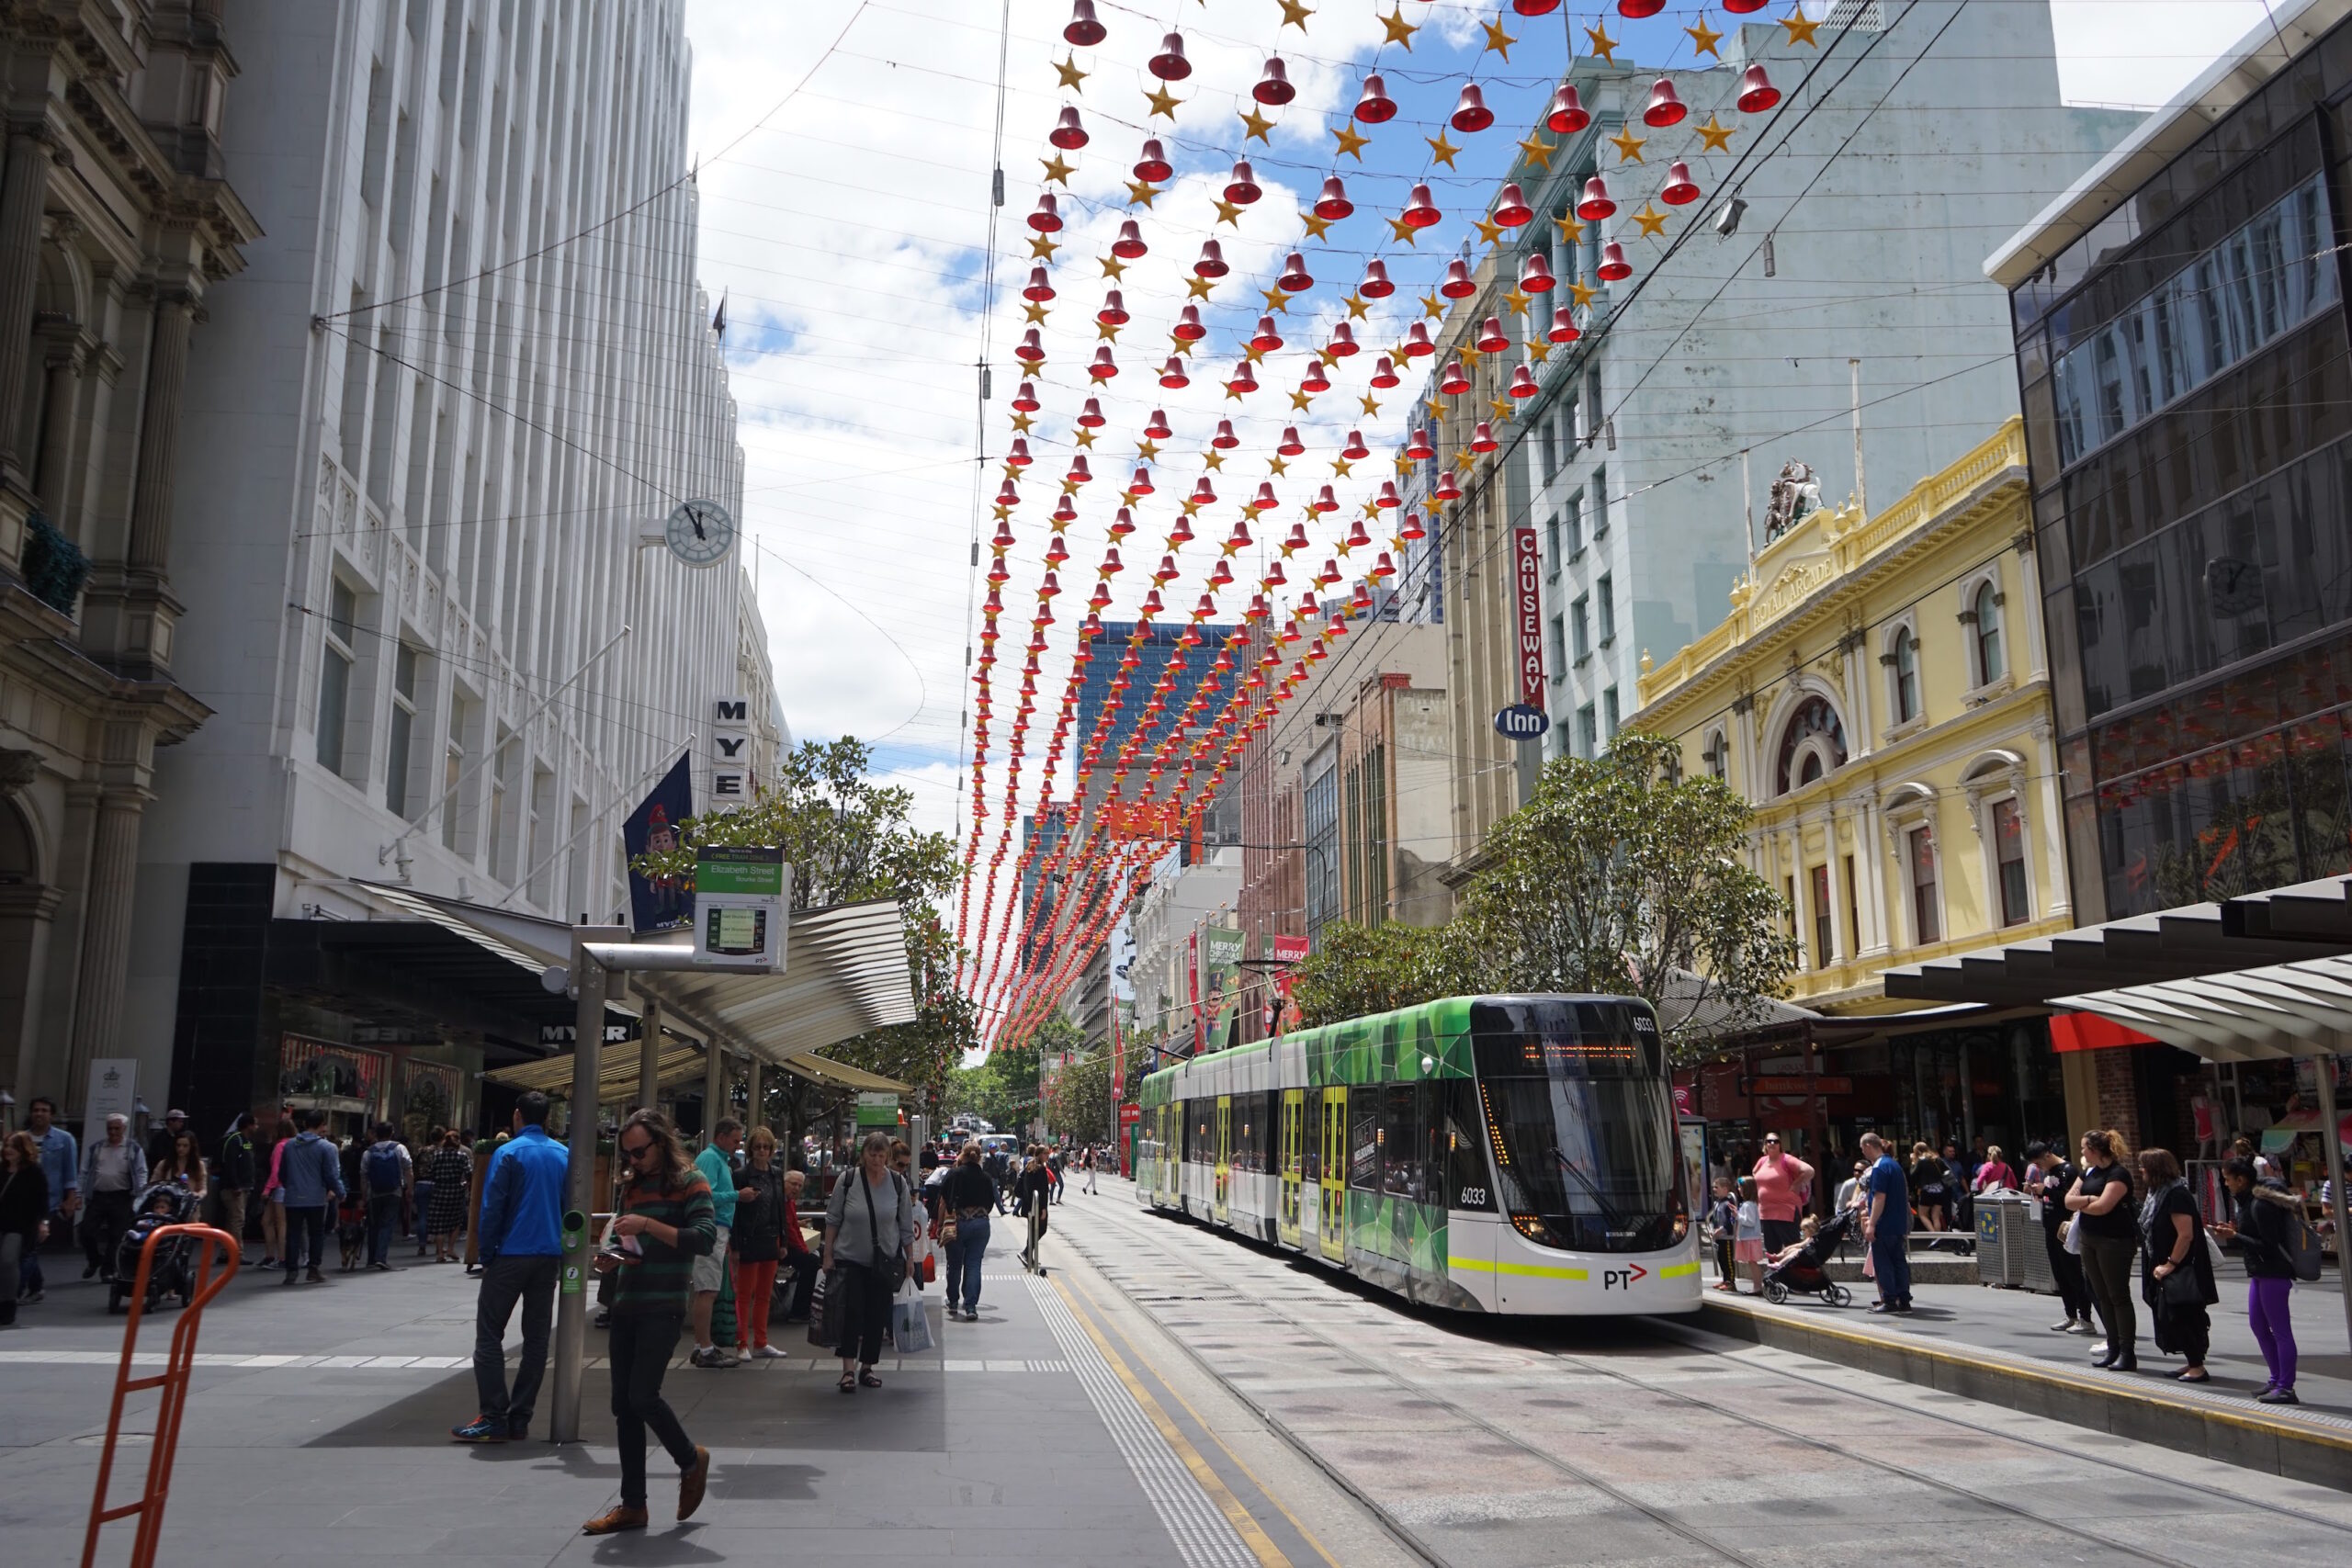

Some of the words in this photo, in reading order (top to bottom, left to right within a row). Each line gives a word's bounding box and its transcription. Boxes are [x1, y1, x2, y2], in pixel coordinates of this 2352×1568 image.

[1754, 591, 1787, 627] ROYAL
[1791, 558, 1833, 602] ARCADE
[1521, 535, 1540, 694] CAUSEWAY
[1506, 710, 1541, 732] Inn
[716, 701, 746, 819] MYE
[711, 865, 748, 874] Elizabeth
[750, 866, 775, 875] Street
[1210, 941, 1241, 953] MERRY
[1276, 949, 1306, 960] MERRY
[1209, 950, 1240, 961] CHRISTMAS
[1633, 1017, 1655, 1032] 6033
[542, 1026, 627, 1040] MYR
[1765, 1078, 1817, 1093] bankwet
[1461, 1187, 1486, 1205] 6033
